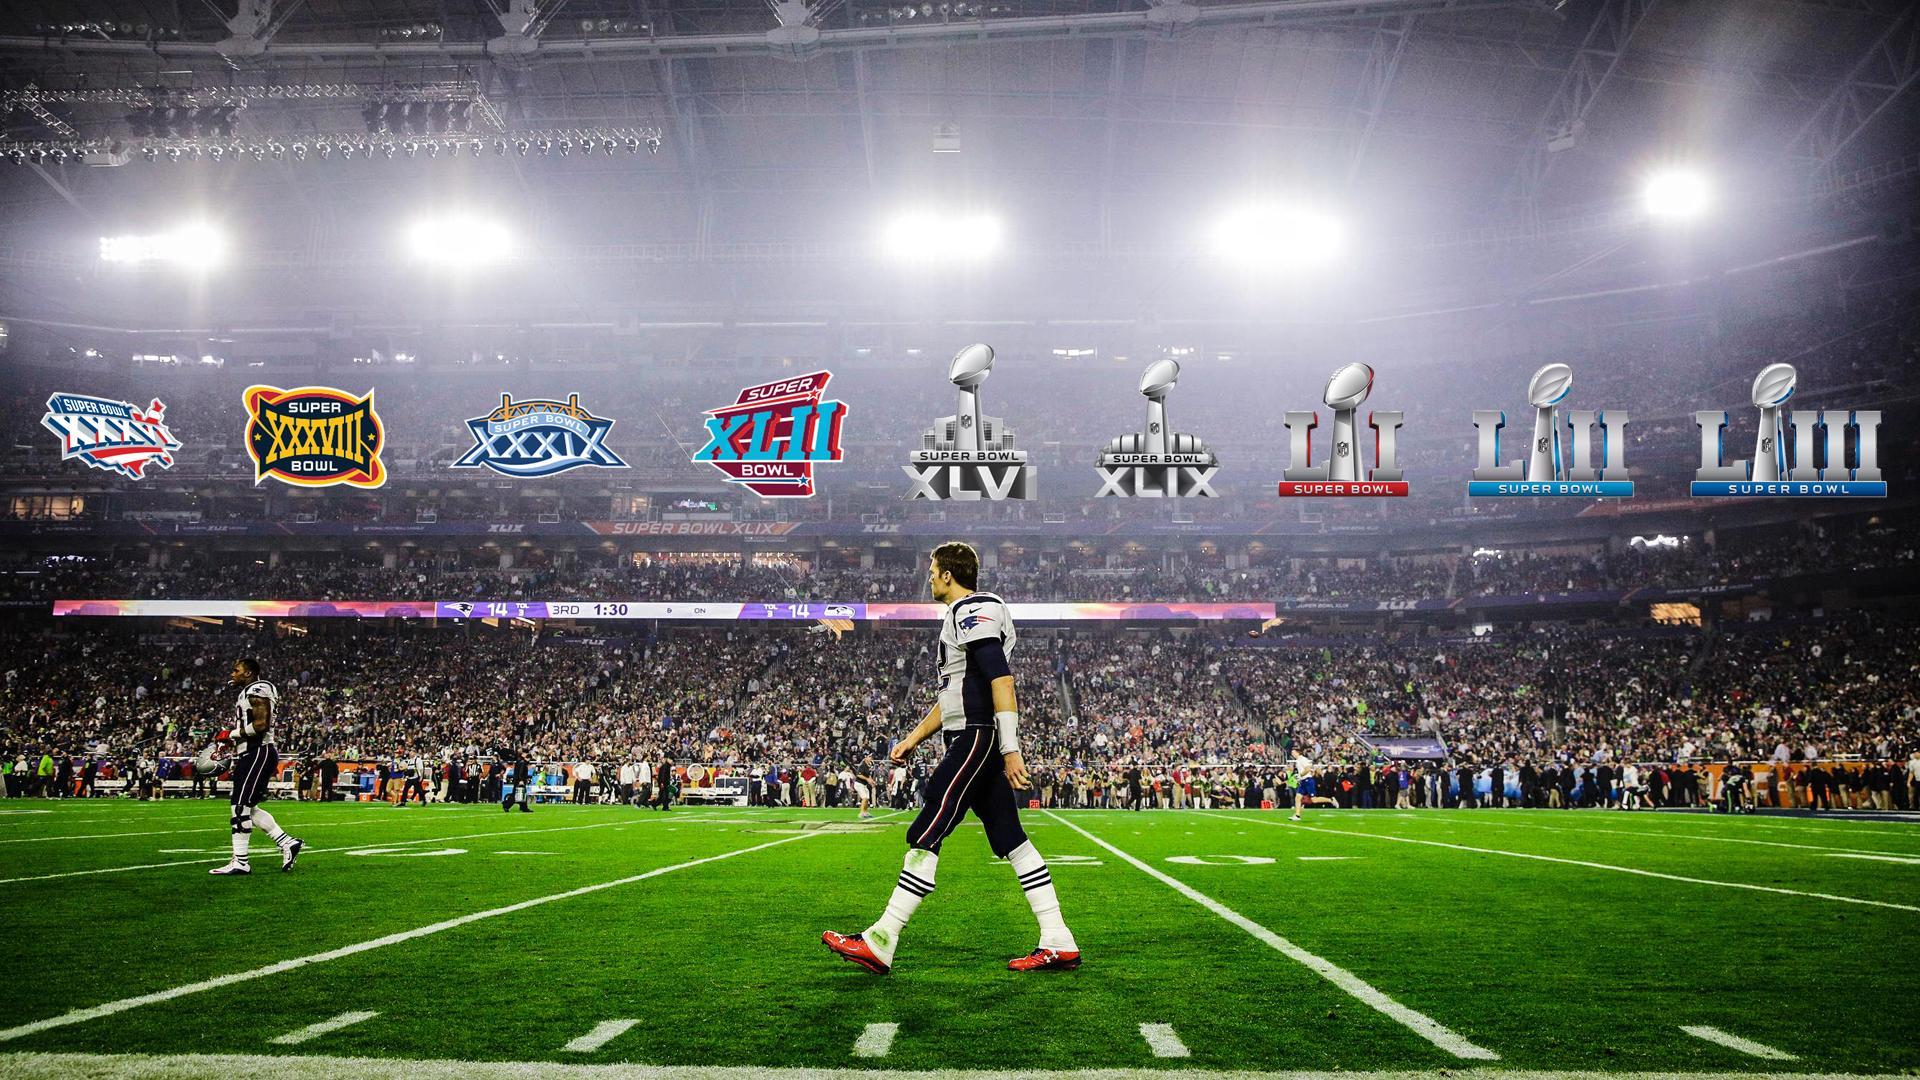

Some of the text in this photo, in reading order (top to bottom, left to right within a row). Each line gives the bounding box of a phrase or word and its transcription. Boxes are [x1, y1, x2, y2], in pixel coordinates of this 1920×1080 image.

[487, 524, 525, 533] XLIX
[612, 523, 776, 534] SUPER BOWL XLIX
[487, 603, 508, 616] 14
[553, 605, 580, 615] 3RD
[594, 604, 628, 616] 1:30
[788, 603, 810, 618] 14
[1375, 600, 1418, 610] XLIX
